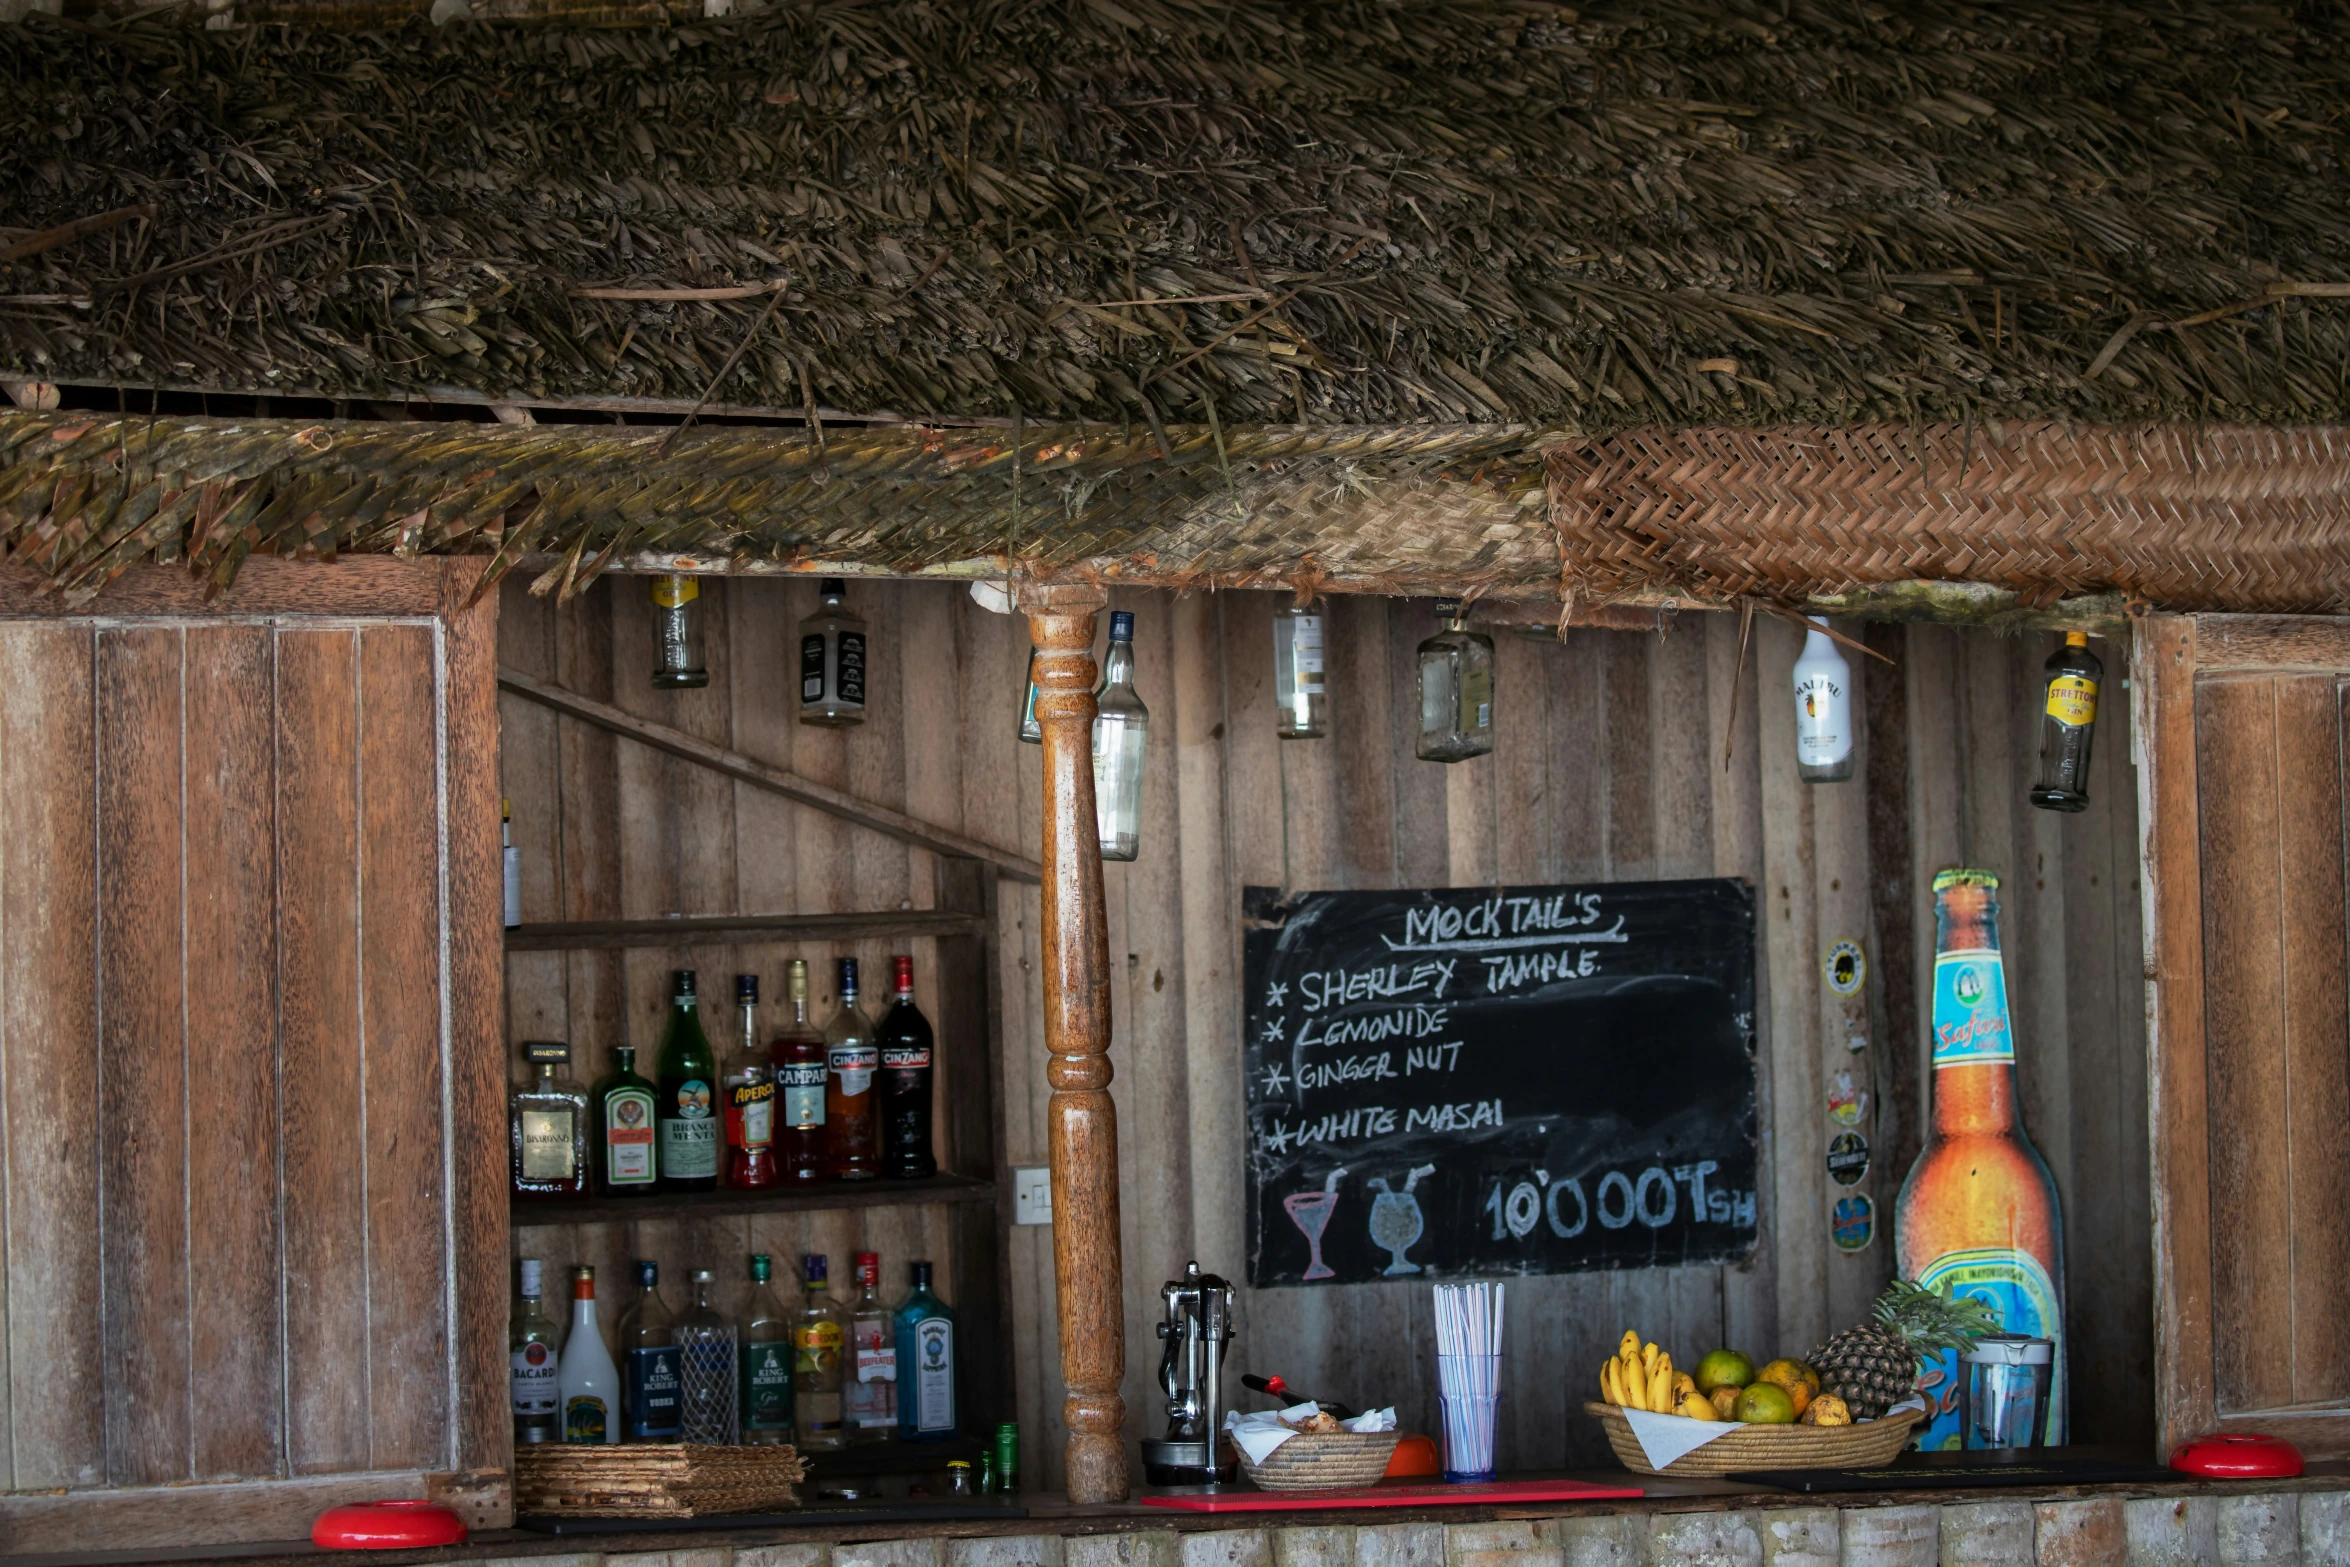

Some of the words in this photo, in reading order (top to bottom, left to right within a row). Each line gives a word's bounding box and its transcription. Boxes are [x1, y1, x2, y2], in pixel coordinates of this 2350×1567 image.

[1299, 958, 1457, 1012] SHERLEY
[1299, 1007, 1449, 1048] LEMONIDE
[1935, 1008, 2006, 1052] Safari
[832, 1052, 877, 1066] CINZANO
[884, 1051, 928, 1066] CINZANO
[1298, 1053, 1398, 1090] GINGER
[1406, 1041, 1464, 1077] NUT
[1297, 1105, 1398, 1146] WHITE
[1405, 1098, 1504, 1133] MASAI
[526, 1134, 570, 1144] DISARONNO
[859, 1356, 896, 1369] BEEFEATER
[650, 1373, 674, 1382] KING
[758, 1368, 784, 1377] KING
[644, 1381, 679, 1390] ROBERT
[752, 1375, 789, 1385] ROBERT
